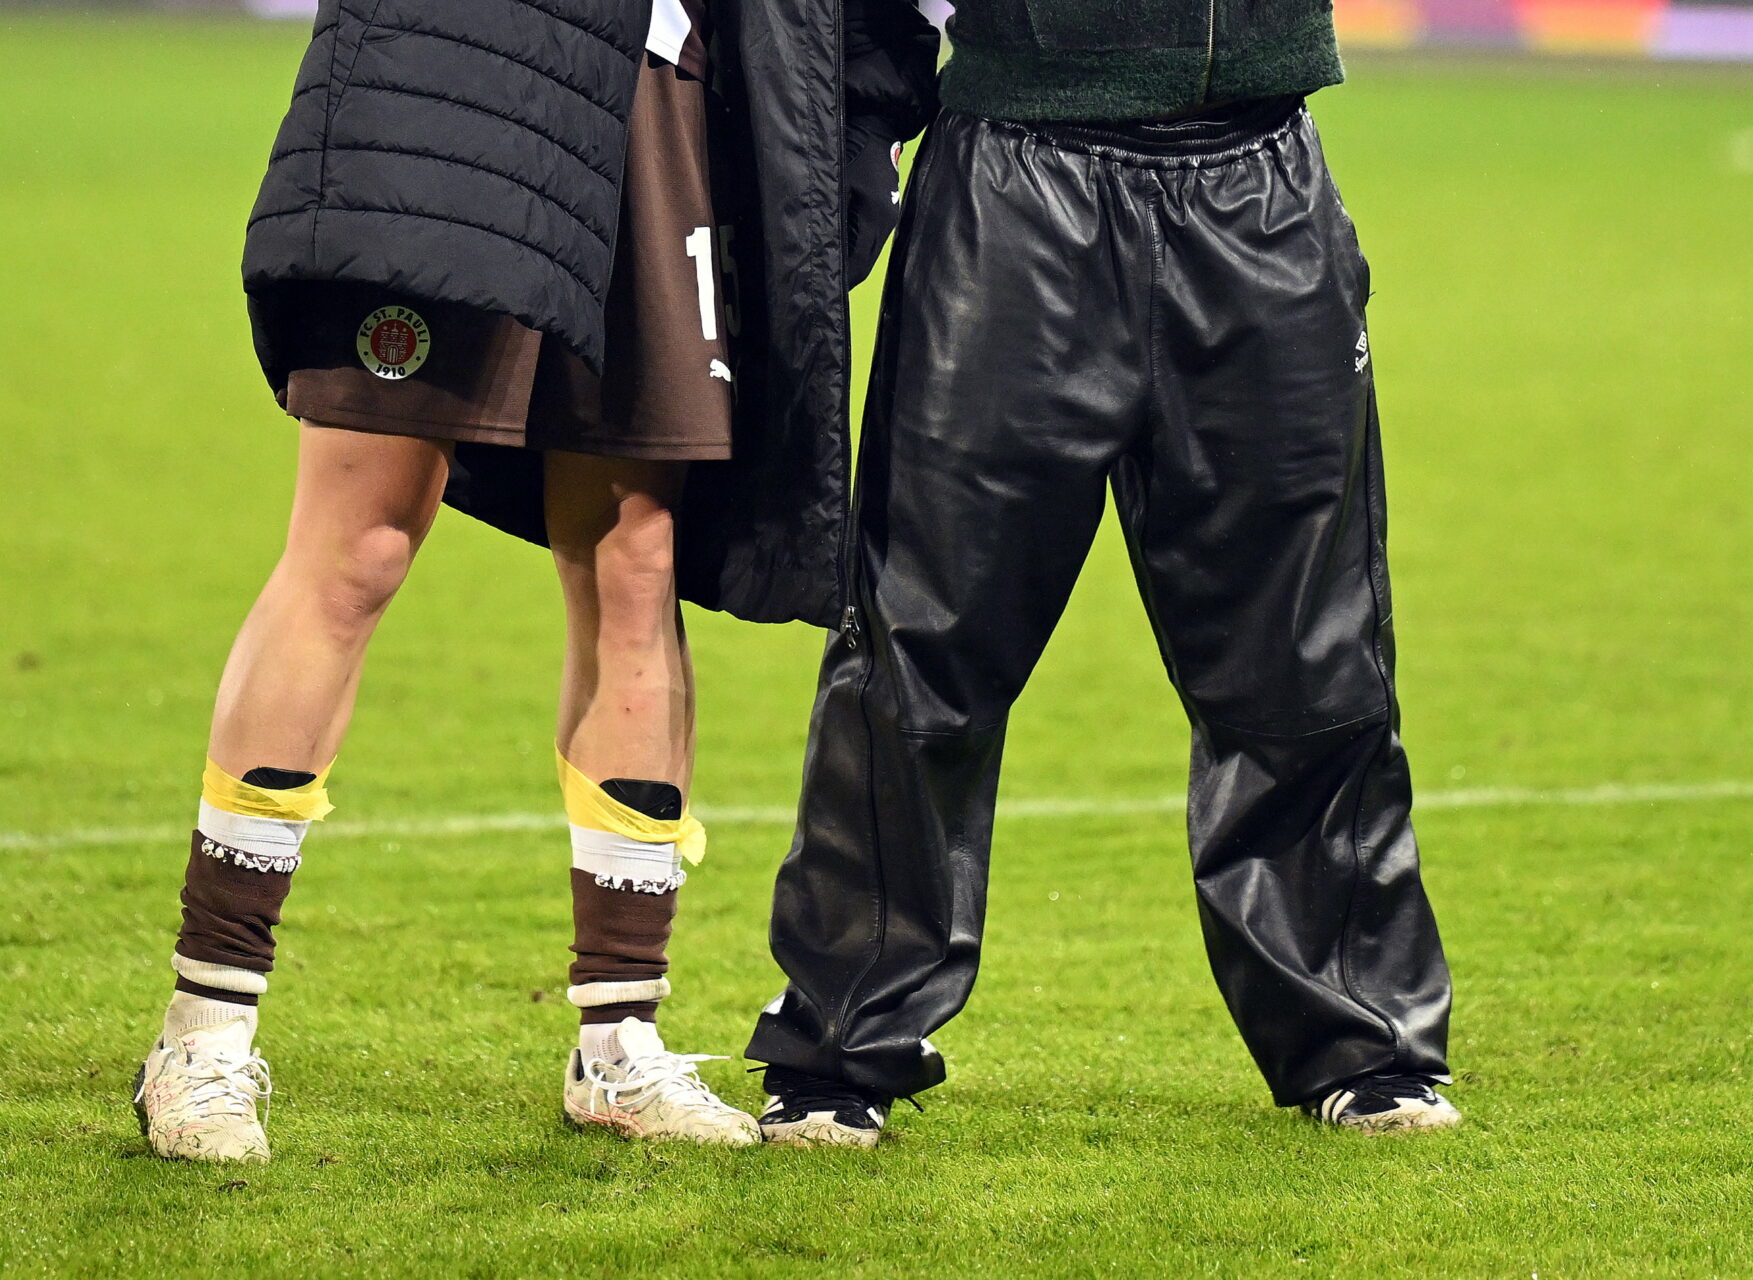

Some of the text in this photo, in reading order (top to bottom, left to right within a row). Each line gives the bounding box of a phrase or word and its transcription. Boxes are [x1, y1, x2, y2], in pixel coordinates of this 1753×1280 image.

[360, 308, 429, 343] FC ST. PAULI
[376, 363, 406, 378] 1910
